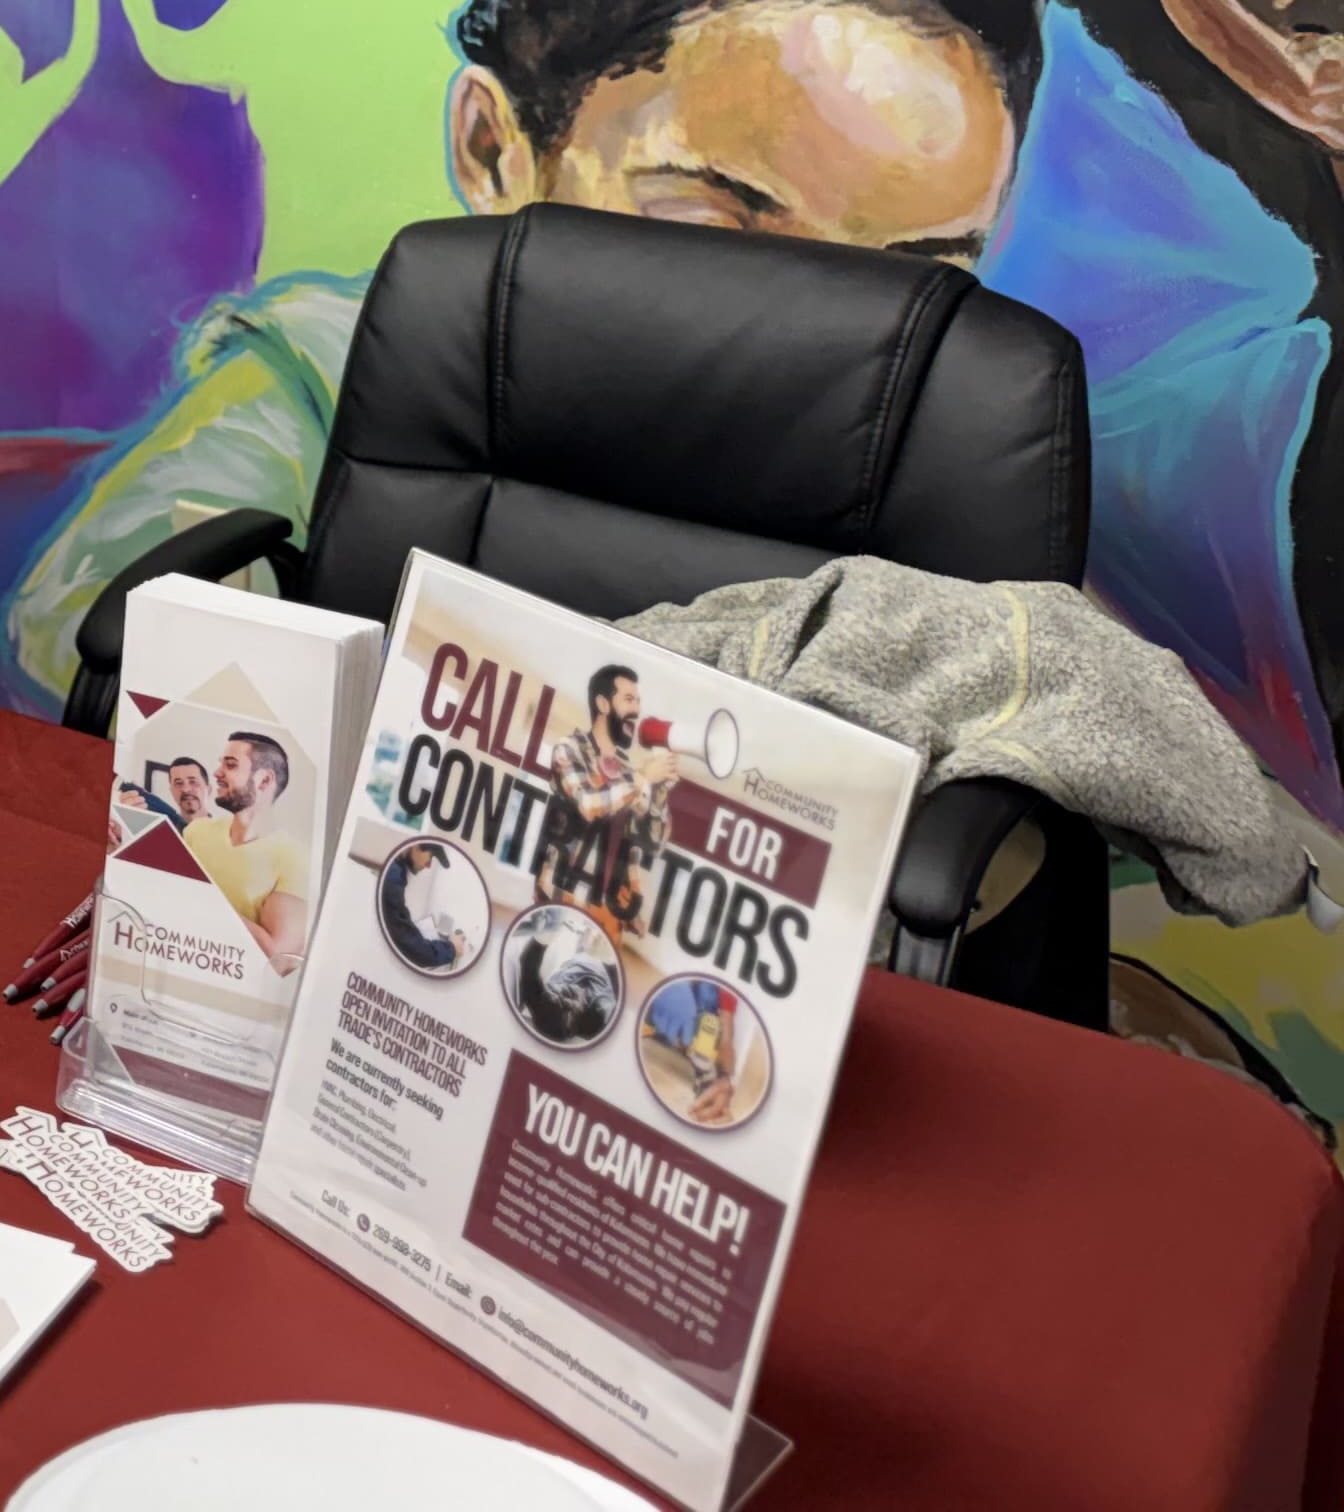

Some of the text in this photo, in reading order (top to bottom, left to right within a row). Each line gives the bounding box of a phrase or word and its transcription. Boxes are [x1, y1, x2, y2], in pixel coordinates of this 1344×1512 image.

[421, 642, 785, 883] CALL FOR
[743, 773, 835, 831] HOMEWORKS
[766, 779, 839, 818] COMMUNITY
[397, 734, 810, 1000] CONTRACTORS
[114, 921, 244, 981] HOMEWORKS
[144, 923, 245, 962] COMMUNITY
[341, 990, 466, 1079] OPEN INVITATION TO ALL
[346, 972, 486, 1065] COMMUNITY HOMEWORKS
[325, 1059, 378, 1099] contractors
[330, 1037, 444, 1120] We are currently seeking
[382, 1037, 461, 1096] CONTRACTORS
[8, 1115, 131, 1220] HOMEWORKS
[49, 1134, 148, 1217] COMMUNITY
[102, 1148, 218, 1213] COMMUNITY
[525, 1084, 748, 1252] YOU CAN HELP!
